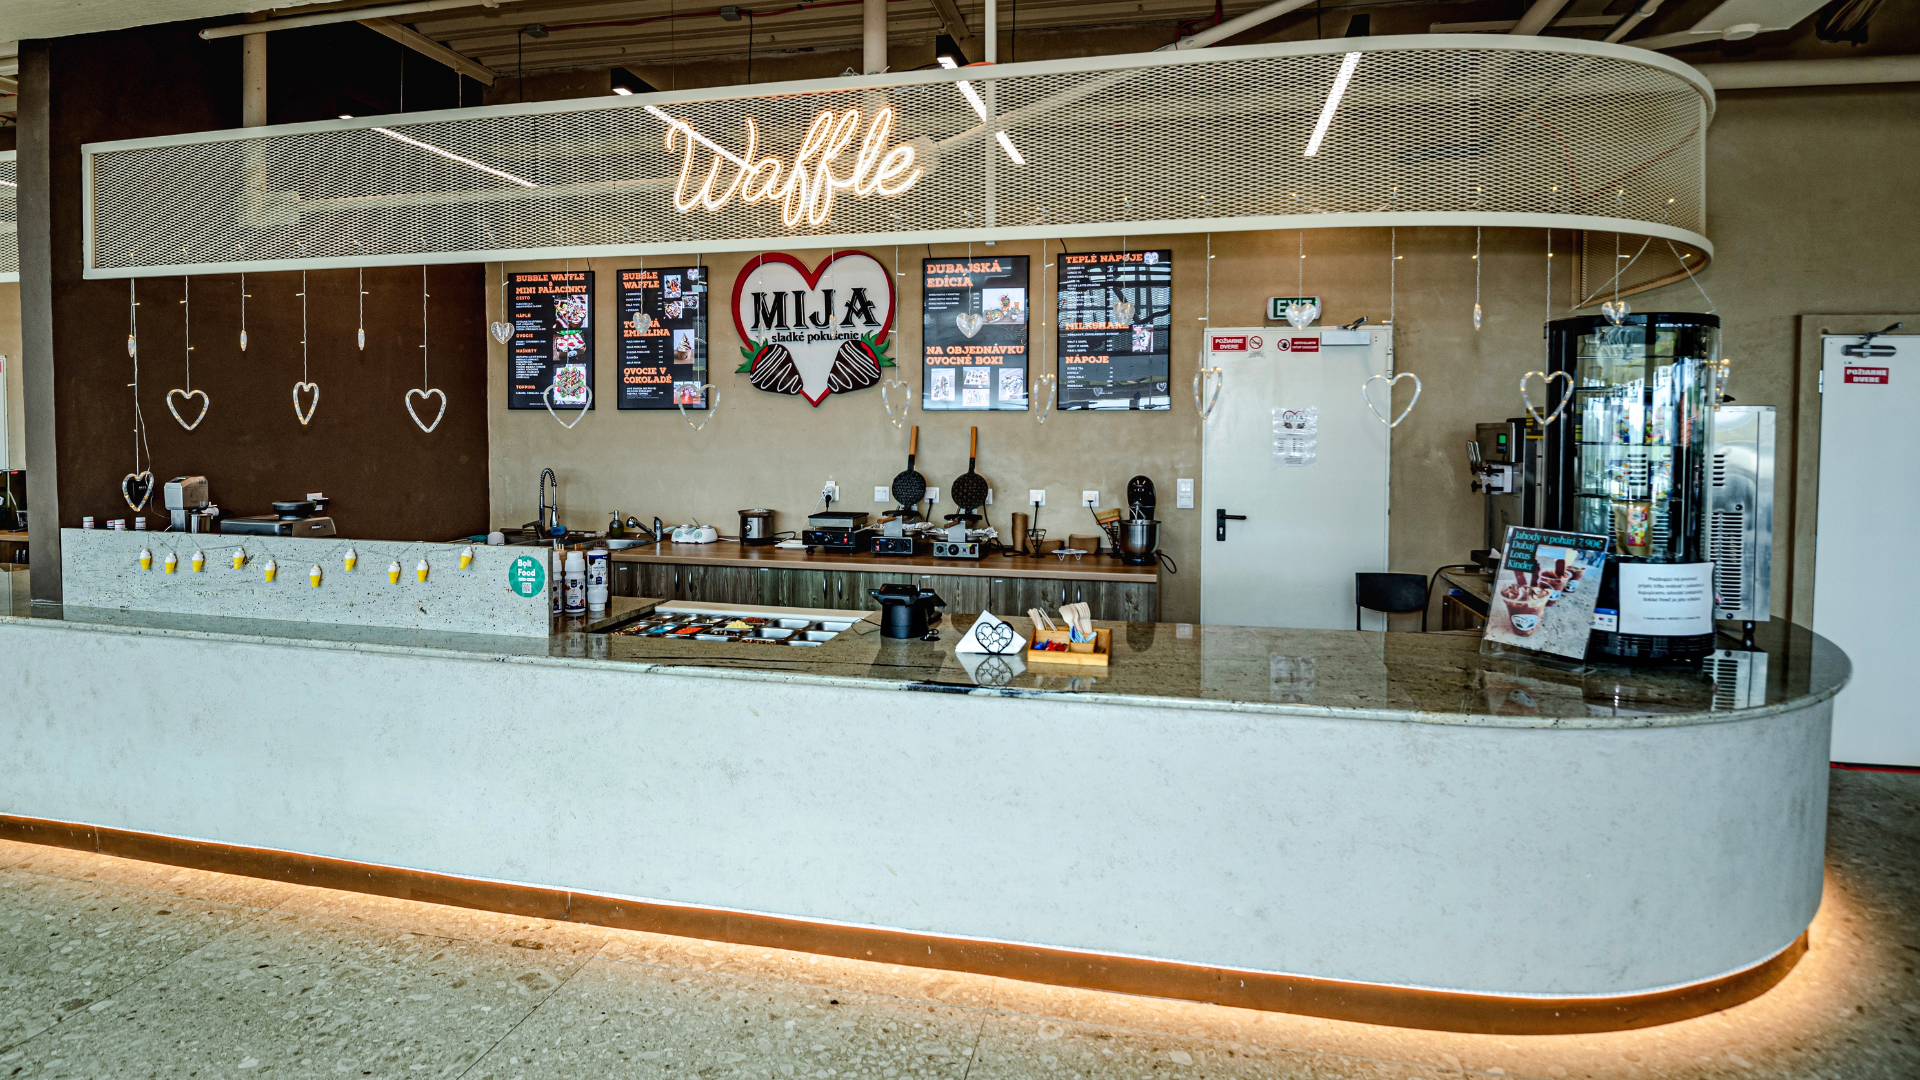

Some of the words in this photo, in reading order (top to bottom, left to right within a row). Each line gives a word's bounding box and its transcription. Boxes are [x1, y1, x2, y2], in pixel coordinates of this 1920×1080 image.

[666, 108, 924, 227] Waffle
[1065, 254, 1098, 264] TEPLÉ
[1100, 253, 1143, 263] NÁPOJE
[926, 259, 1002, 274] DUBAJSKÁ
[516, 274, 548, 282] BUBBLE
[551, 273, 585, 281] WAFFLE
[622, 271, 658, 281] BUBBLE
[926, 274, 974, 288] EDÍCIA
[515, 286, 536, 295] MINI
[538, 285, 587, 294] PALACINKY
[623, 280, 660, 289] WAFFLE
[749, 287, 882, 331] MIJA
[1277, 299, 1313, 316] ET
[623, 328, 670, 337] ZMLINA
[771, 331, 805, 343] sladké
[807, 330, 860, 345] pokušenie
[926, 346, 943, 355] NA
[946, 343, 1025, 354] OBJEDNÁVKU
[926, 354, 972, 365] OVOCNÉ
[975, 356, 1003, 365] BOXI
[1065, 354, 1109, 364] NÁPOJE
[624, 367, 657, 375] OVOCIE
[659, 367, 667, 375] V
[1846, 368, 1887, 376] POŽIARNE
[1514, 531, 1541, 543] Jahody
[1548, 536, 1576, 546] pohári
[1511, 540, 1536, 552] Dubaj
[1509, 550, 1531, 559] Lotus
[517, 559, 532, 569] Bolt
[1507, 559, 1534, 571] Kinder
[517, 568, 536, 577] Food
